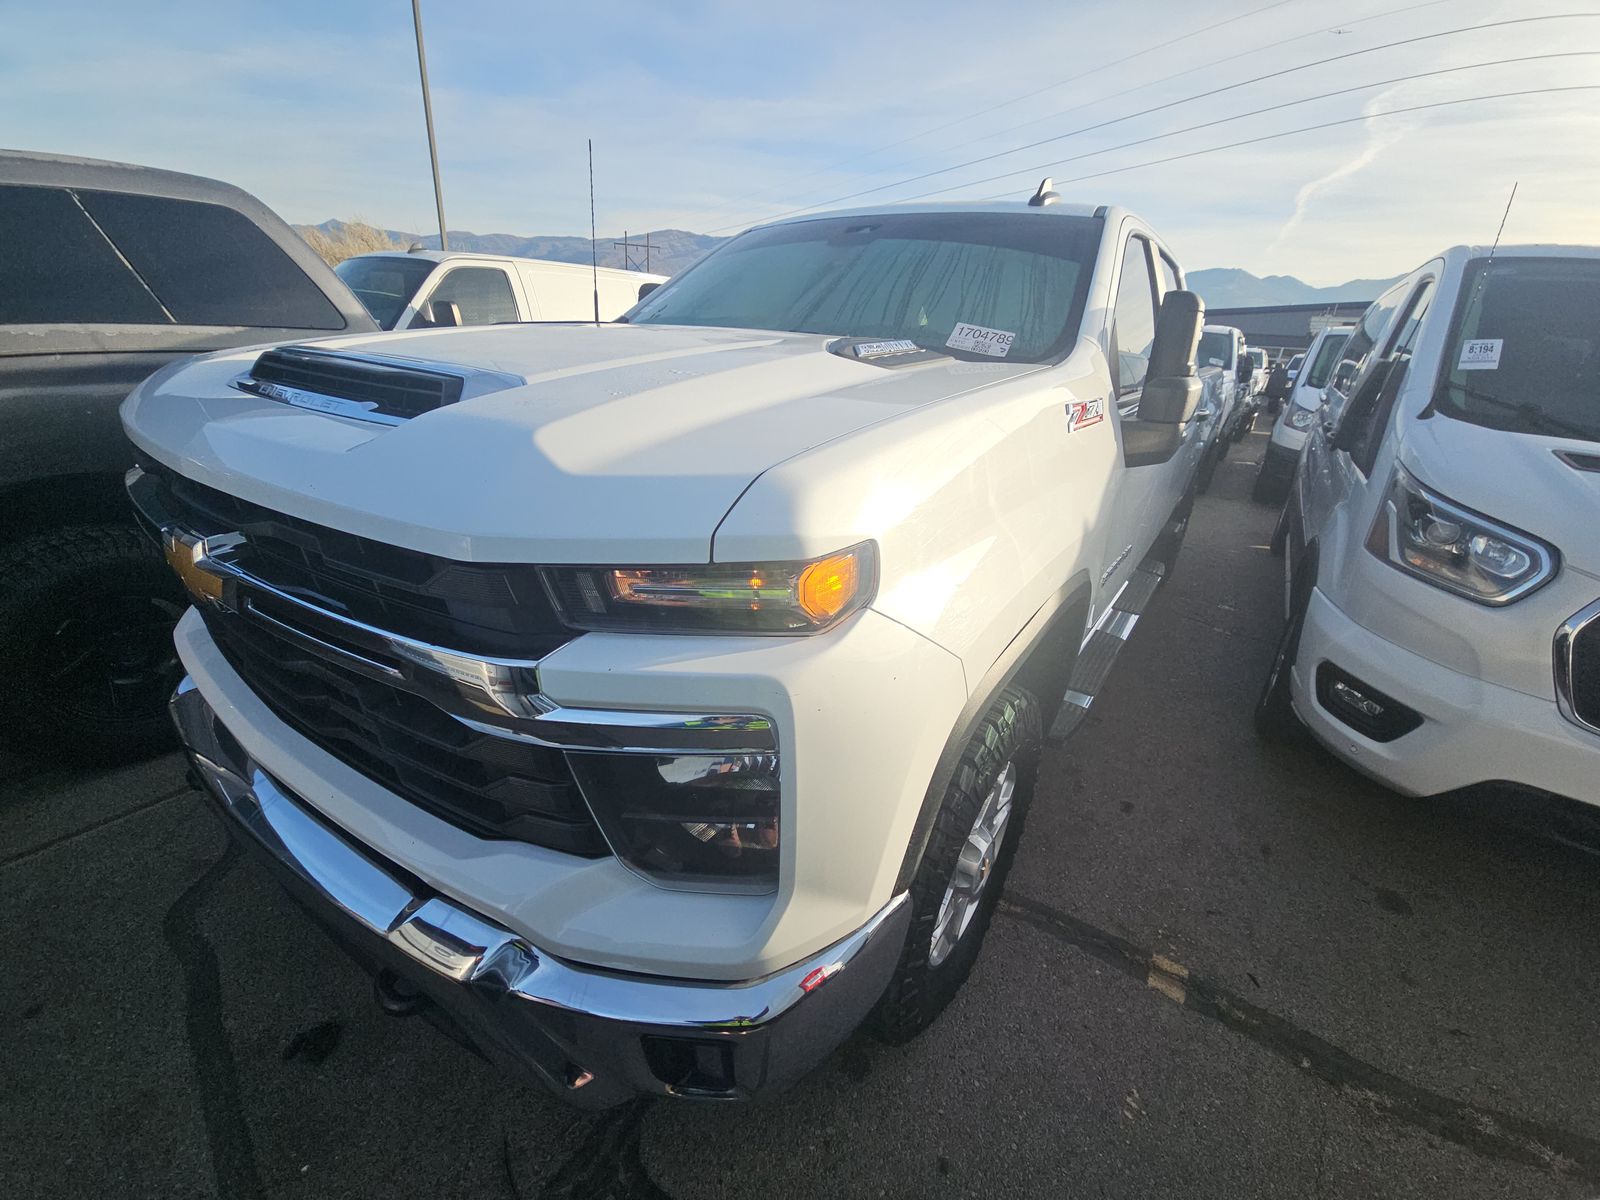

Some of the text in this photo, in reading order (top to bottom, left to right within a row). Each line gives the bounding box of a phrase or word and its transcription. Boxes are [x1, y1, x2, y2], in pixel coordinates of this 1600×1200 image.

[958, 326, 1014, 346] 1704789
[1468, 345, 1494, 354] 8:194
[259, 384, 345, 413] CHEVROLET
